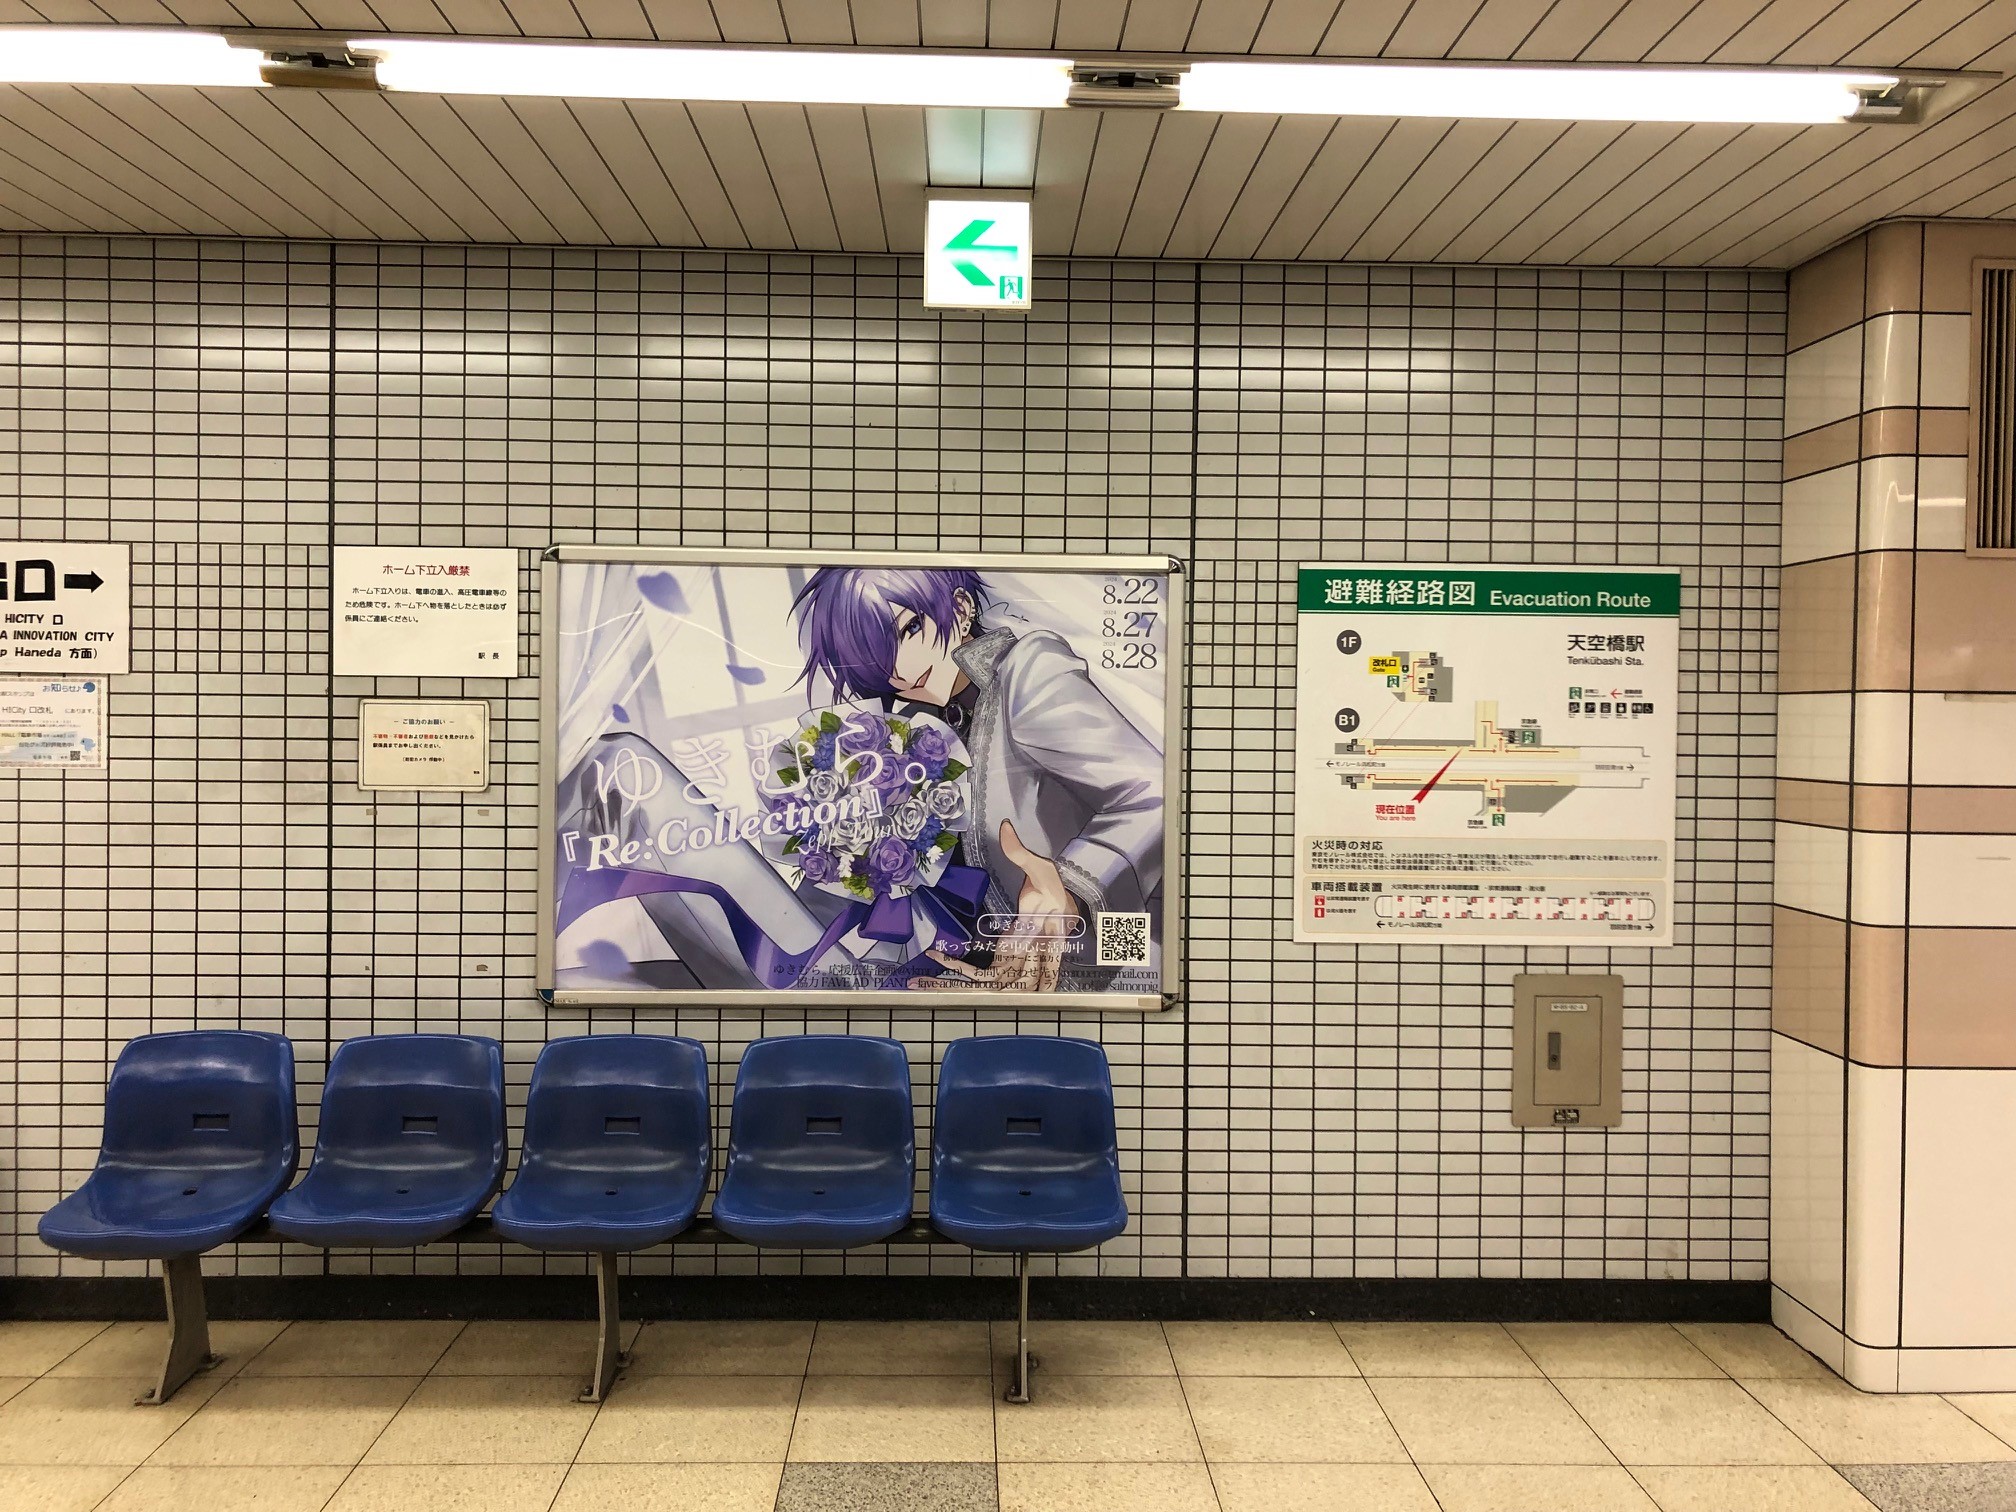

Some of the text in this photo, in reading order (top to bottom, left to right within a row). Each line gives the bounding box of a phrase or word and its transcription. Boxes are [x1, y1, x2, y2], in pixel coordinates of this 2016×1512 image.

[382, 564, 471, 577] ホーム下立入厳禁
[1102, 578, 1159, 605] 8.22
[1324, 578, 1651, 608] 避難経路図 Evacuation Route
[5, 613, 44, 624] HICITY
[344, 615, 419, 624] 係員にご連絡ください。
[1101, 611, 1159, 638] 8.27
[13, 630, 77, 641] INNOVATION
[84, 631, 115, 641] CITY
[1341, 636, 1358, 648] 1F
[1567, 634, 1645, 652] 天空橋駅
[15, 647, 61, 657] Haneda
[1101, 642, 1158, 670] 8.28
[1372, 658, 1397, 667] 改札口
[1625, 656, 1645, 666] Sta.
[1338, 714, 1356, 726] B1
[592, 717, 927, 817] ゆきむら。
[1375, 804, 1416, 815] 現在位置
[1311, 840, 1384, 851] 火災時の対応
[1311, 881, 1383, 893] 車両搭載装置
[935, 939, 1084, 954] 歌ってみたを中心に活動中
[821, 977, 850, 988] FAVE
[853, 977, 869, 988] AD
[873, 977, 909, 988] PLANT
